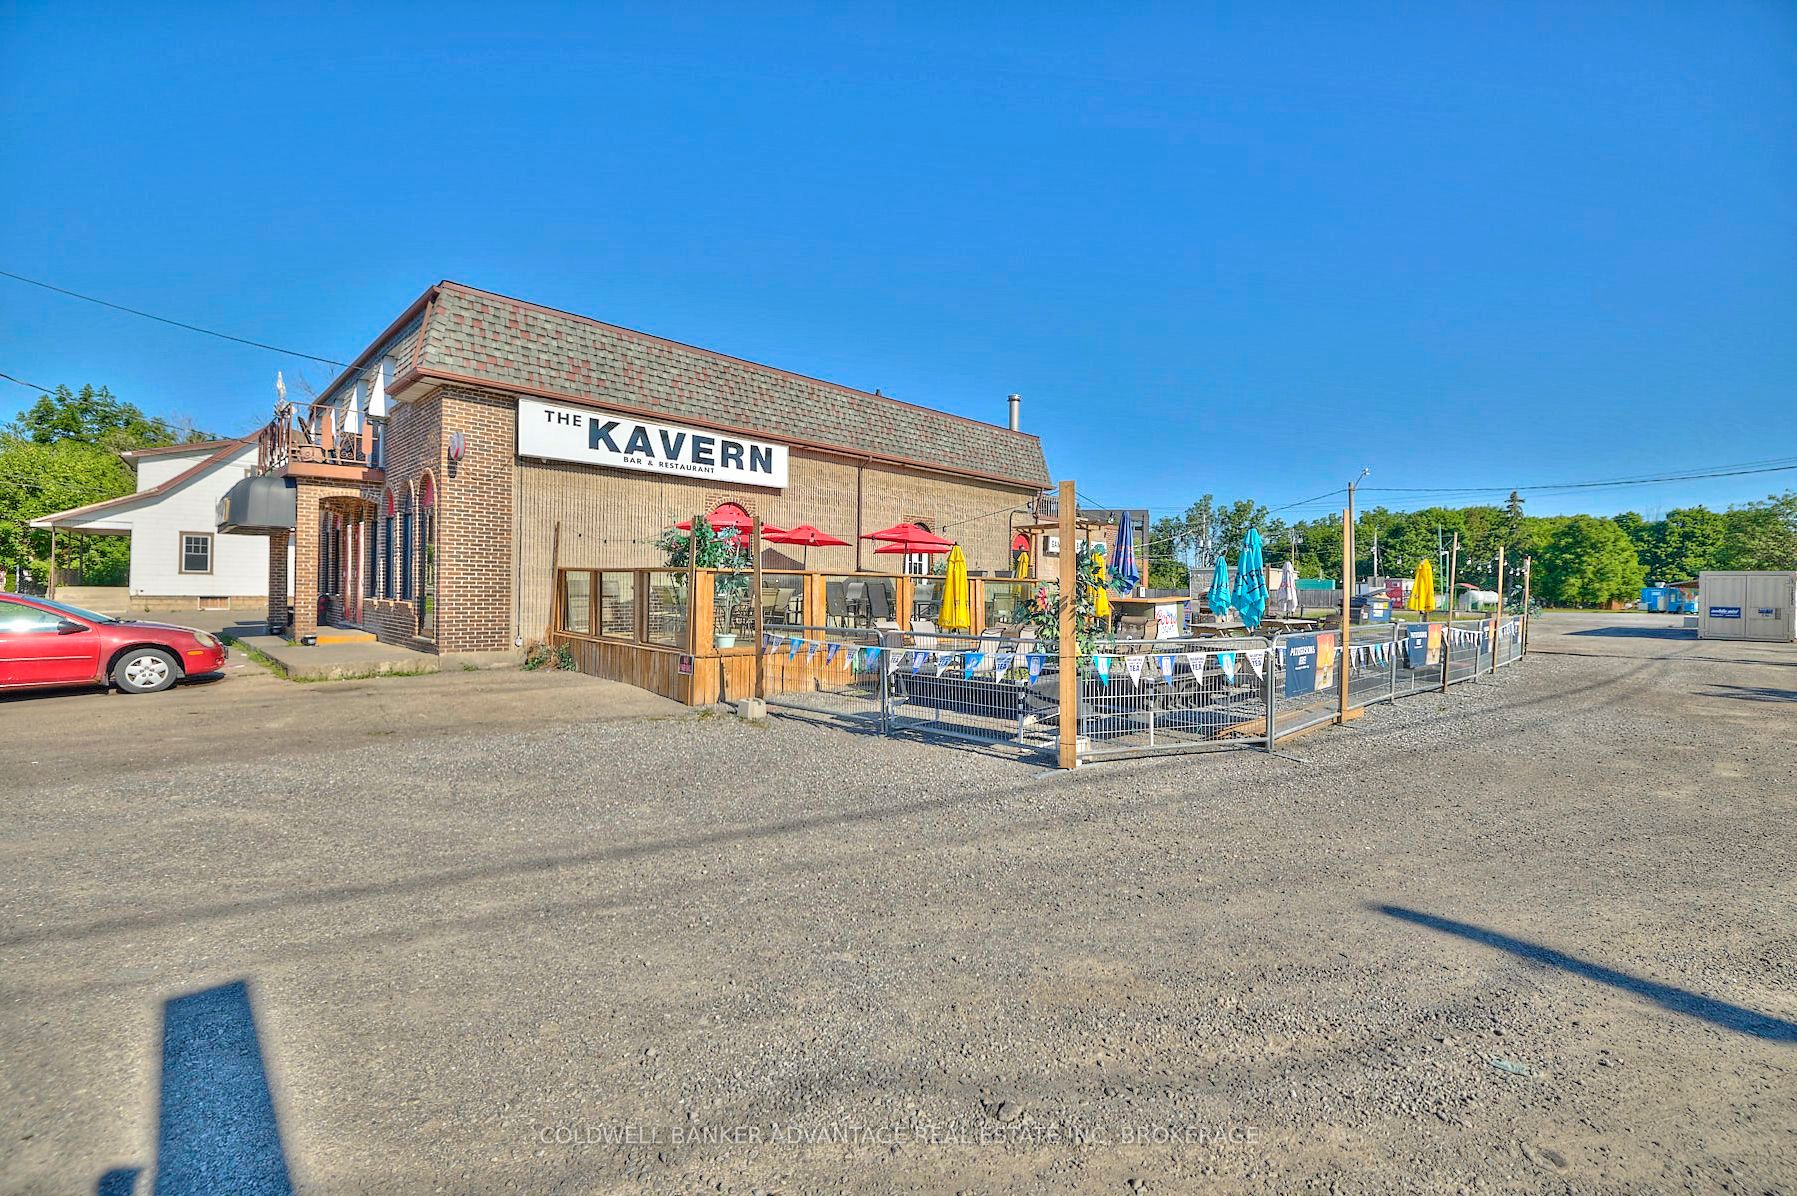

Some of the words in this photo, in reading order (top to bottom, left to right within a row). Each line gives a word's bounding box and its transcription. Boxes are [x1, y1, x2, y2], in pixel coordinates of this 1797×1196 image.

[544, 410, 582, 427] THE
[588, 417, 773, 475] KAVERN
[623, 456, 643, 465] BAR
[647, 459, 654, 467] &
[658, 461, 715, 474] RESTAURANT
